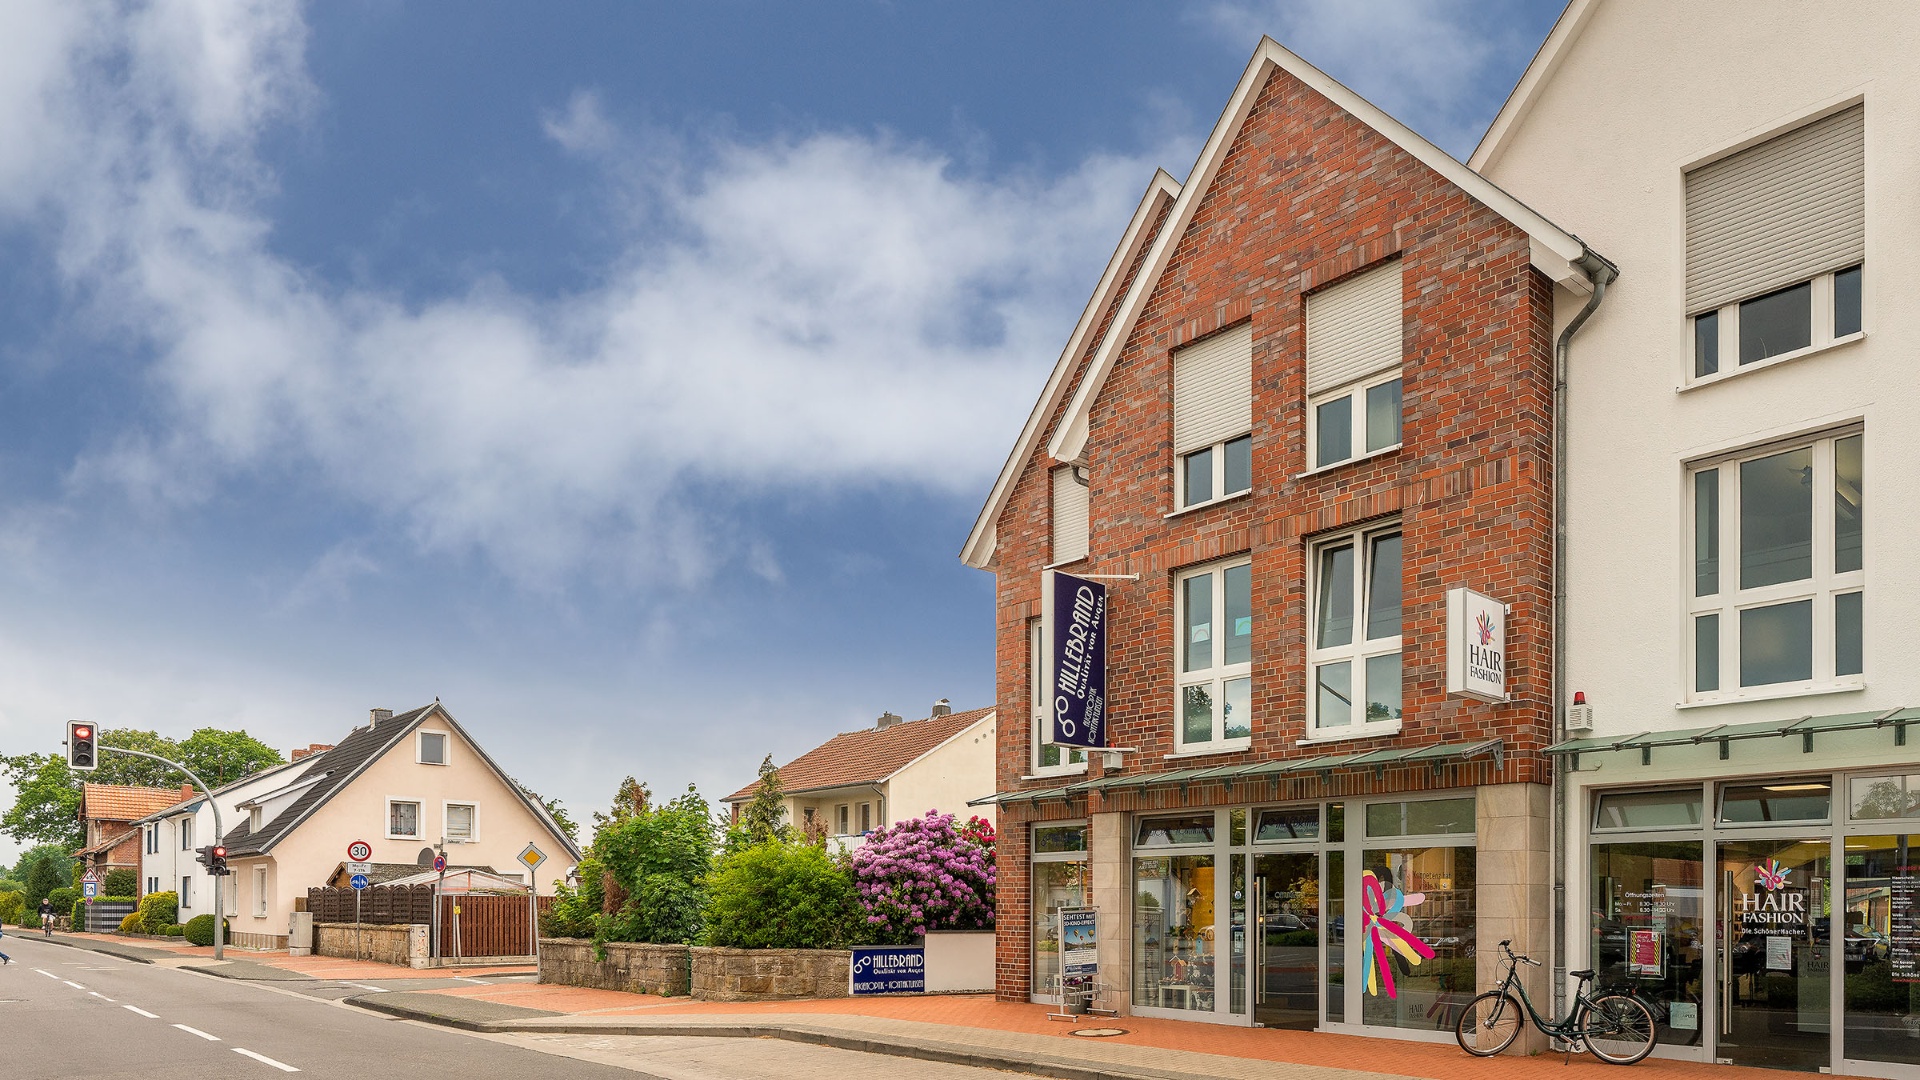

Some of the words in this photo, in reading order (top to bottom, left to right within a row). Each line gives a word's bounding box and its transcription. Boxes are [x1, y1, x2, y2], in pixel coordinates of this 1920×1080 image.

[1058, 585, 1094, 695] HILLEBRAND
[1470, 643, 1502, 672] HAIR
[1470, 665, 1502, 685] FASHION
[352, 846, 367, 857] 30
[1742, 893, 1806, 912] HAIR
[1742, 912, 1804, 924] FASHION
[873, 954, 924, 968] HILLEBRAND
